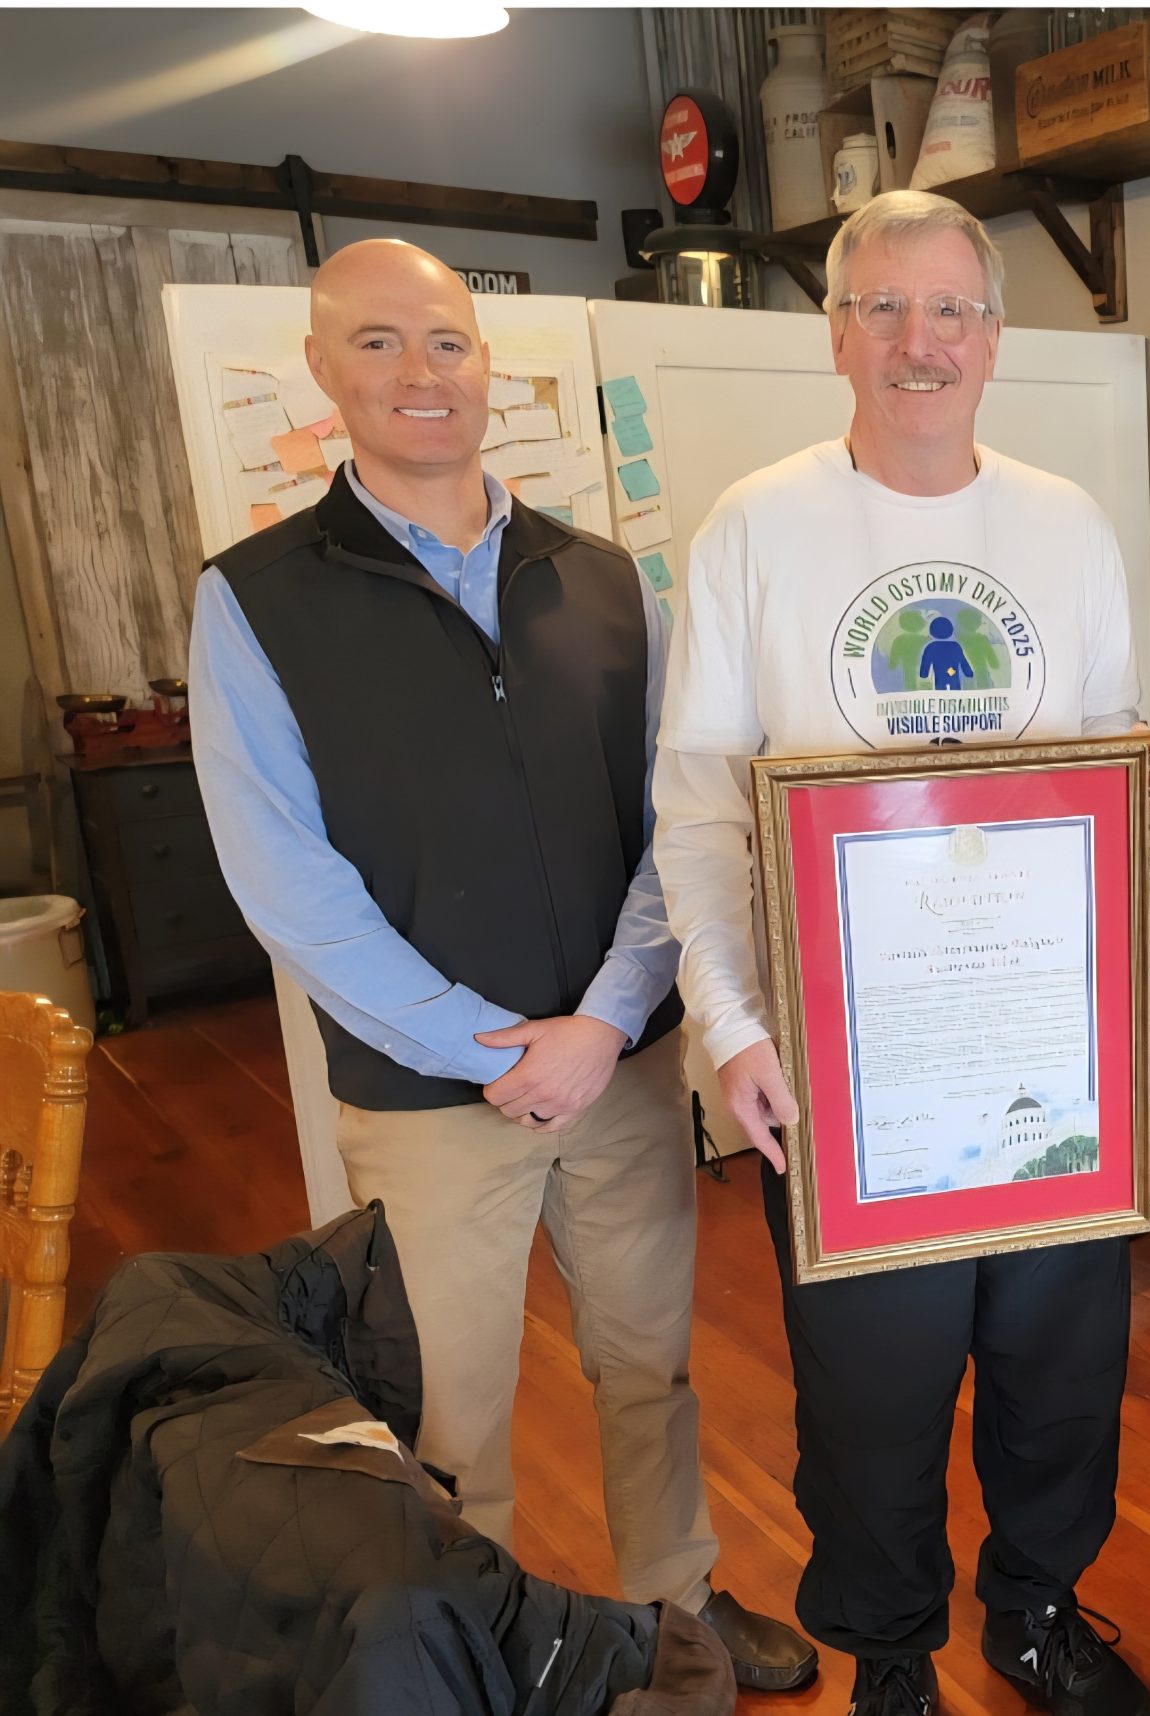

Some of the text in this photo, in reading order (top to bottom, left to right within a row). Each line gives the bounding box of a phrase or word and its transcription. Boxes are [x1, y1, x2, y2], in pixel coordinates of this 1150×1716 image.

[1092, 60, 1131, 89] MILK
[843, 572, 1035, 658] WORLD OSTOMY DAY 2025
[887, 712, 1003, 735] VISIBLE SUPPORT
